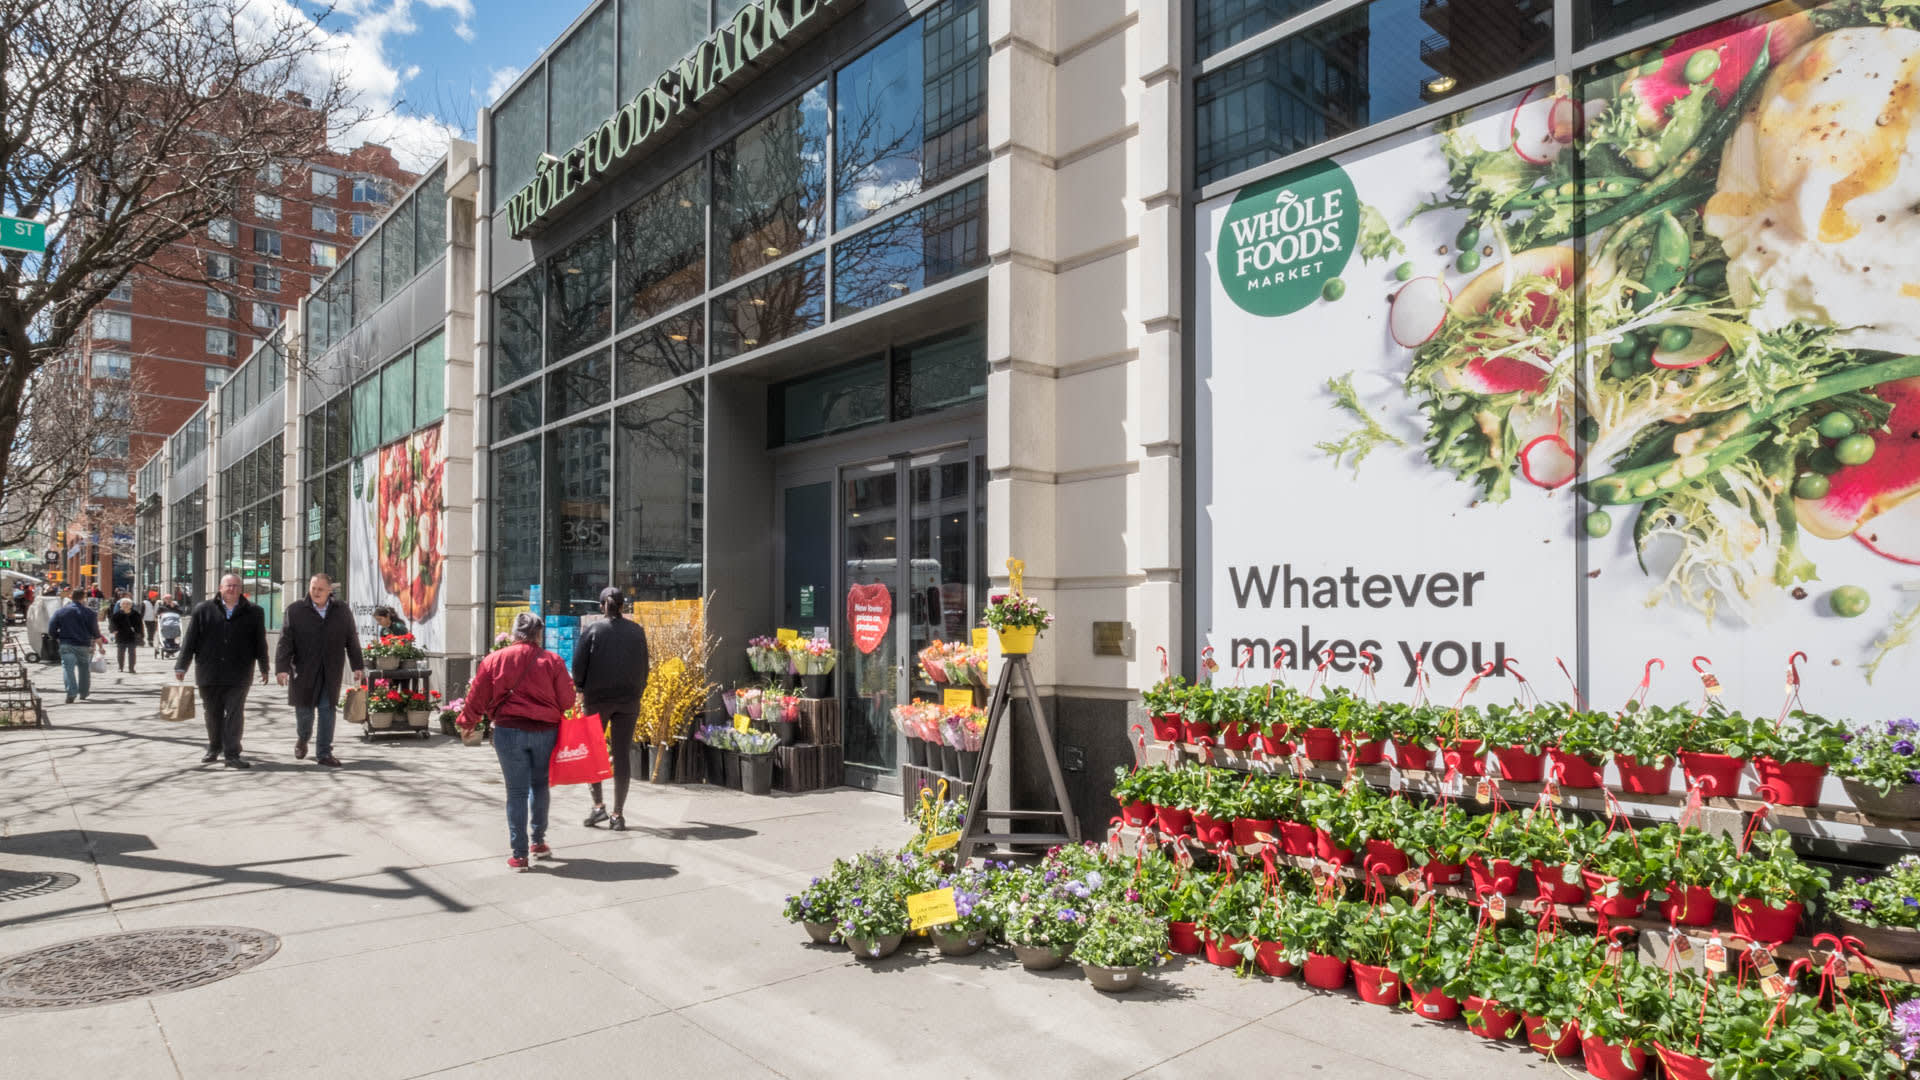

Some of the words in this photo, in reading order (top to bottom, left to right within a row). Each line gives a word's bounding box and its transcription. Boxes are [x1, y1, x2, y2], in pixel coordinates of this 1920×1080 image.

[504, 152, 579, 240] WHOLE
[581, 70, 672, 185] FOODS
[674, 0, 832, 115] MARK
[15, 222, 35, 237] ST
[1229, 189, 1343, 247] WHOLE
[1236, 221, 1341, 276] FOODS
[1247, 261, 1323, 291] MARKET
[562, 520, 602, 546] 365
[1228, 563, 1485, 609] Whatever
[854, 603, 868, 613] New
[856, 614, 873, 622] prices
[1231, 625, 1384, 673] makes
[1397, 640, 1506, 688] you
